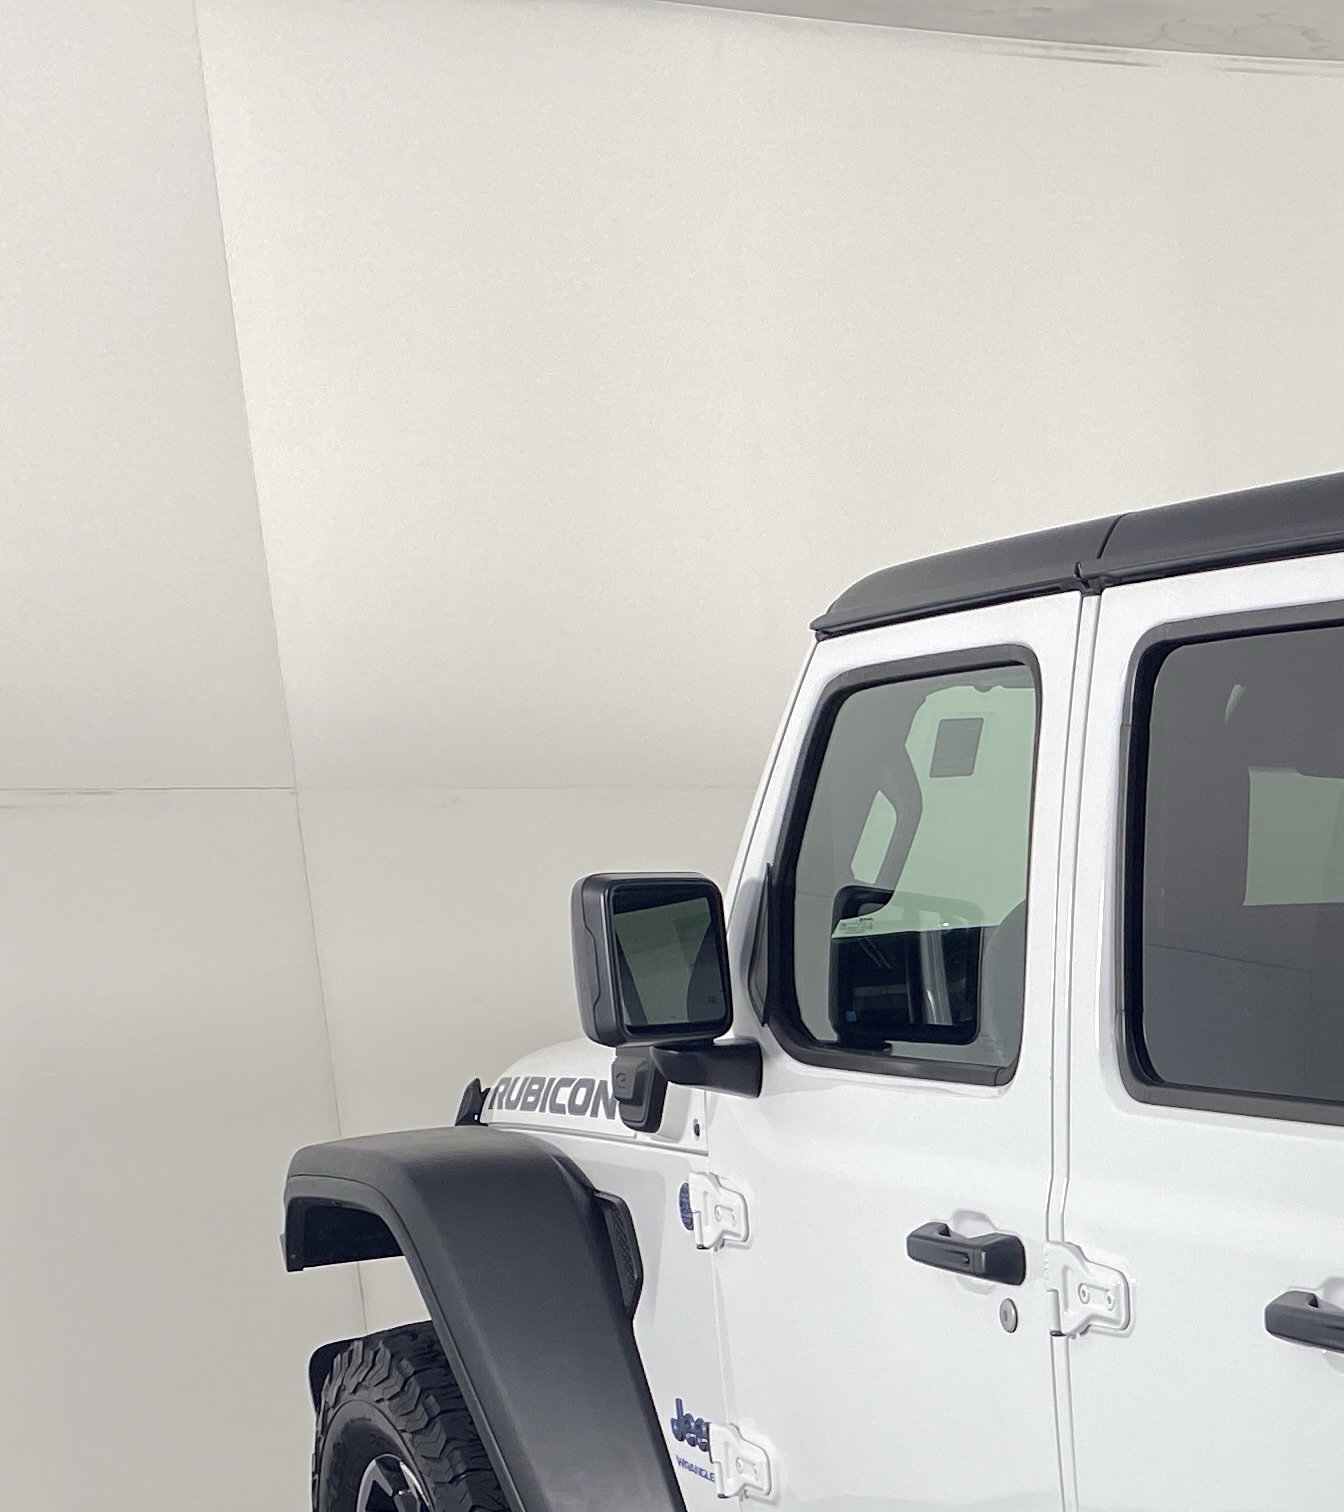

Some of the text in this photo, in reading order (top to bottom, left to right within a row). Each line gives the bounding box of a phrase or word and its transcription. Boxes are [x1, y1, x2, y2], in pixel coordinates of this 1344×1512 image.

[488, 1076, 617, 1120] RUBICON
[671, 1397, 709, 1452] Jee
[676, 1454, 715, 1483] WRANGLE
